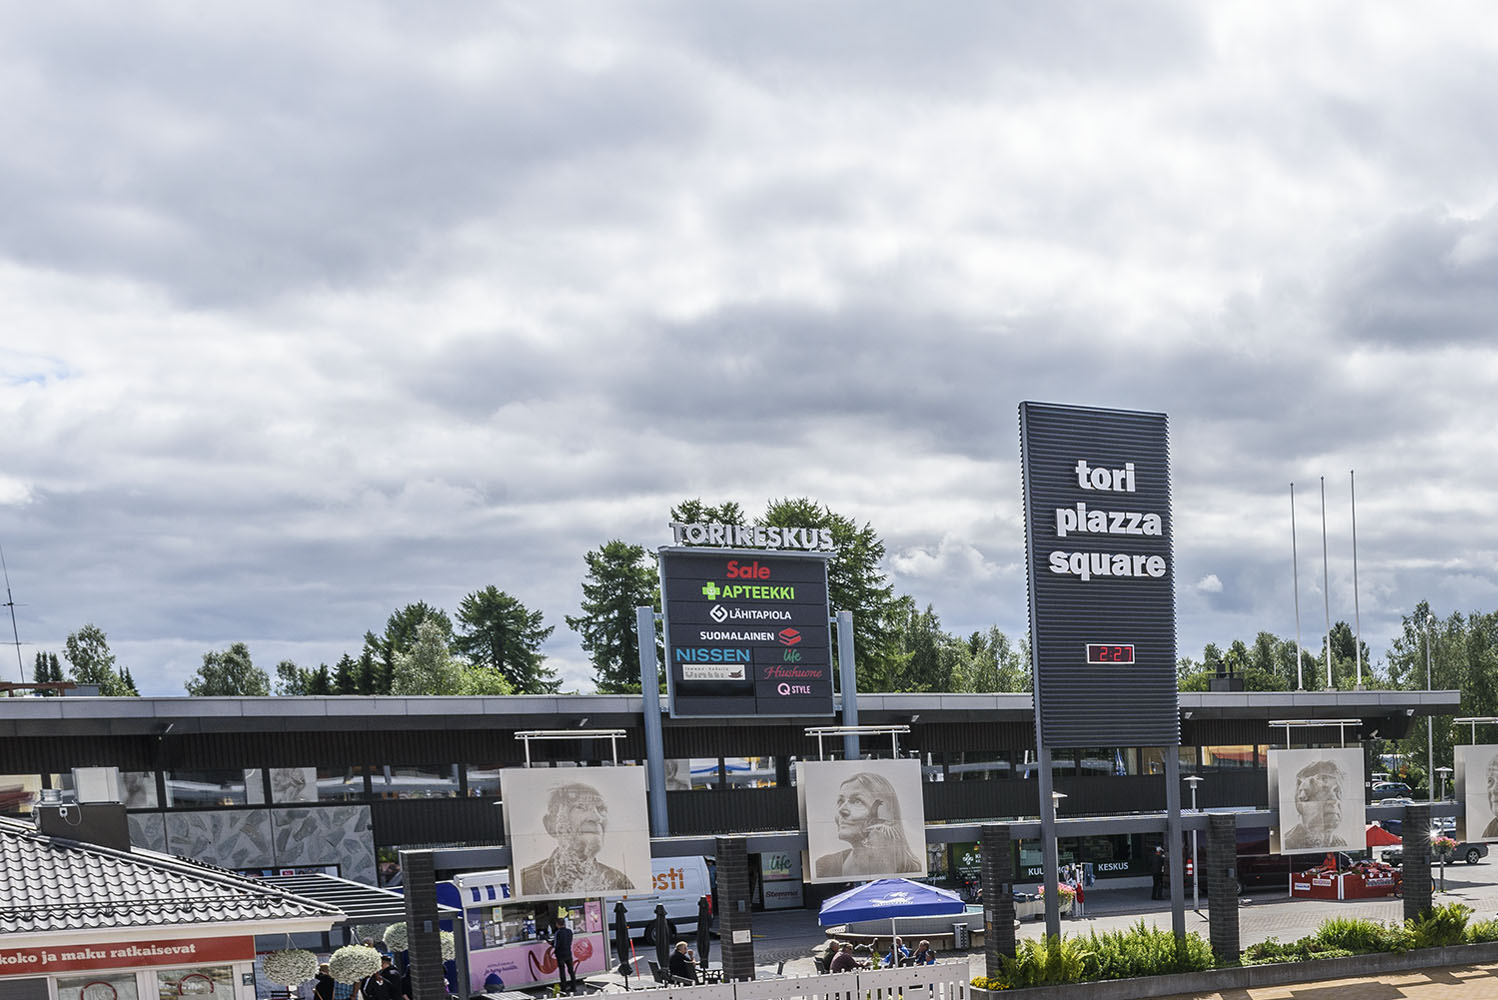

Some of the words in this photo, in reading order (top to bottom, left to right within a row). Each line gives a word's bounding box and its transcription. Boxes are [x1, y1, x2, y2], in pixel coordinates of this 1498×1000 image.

[1076, 460, 1136, 492] tori
[1056, 502, 1163, 537] piazza
[669, 522, 834, 550] TORIKESKUS
[726, 560, 771, 579] Sale
[1049, 550, 1167, 581] square
[722, 584, 795, 600] APTEEKKI
[729, 608, 792, 620] LÄHITAPIOLA
[700, 631, 775, 641] SUOMALAINEN
[676, 648, 750, 662] NISSEN
[783, 649, 802, 663] life
[764, 665, 823, 680] Hiushuone
[777, 682, 790, 695] Q
[791, 685, 811, 694] STYLE
[771, 854, 793, 871] life
[1098, 861, 1129, 872] KESKUS
[41, 951, 57, 965] ja
[61, 948, 107, 961] maku
[110, 944, 196, 959] ratkaisevat
